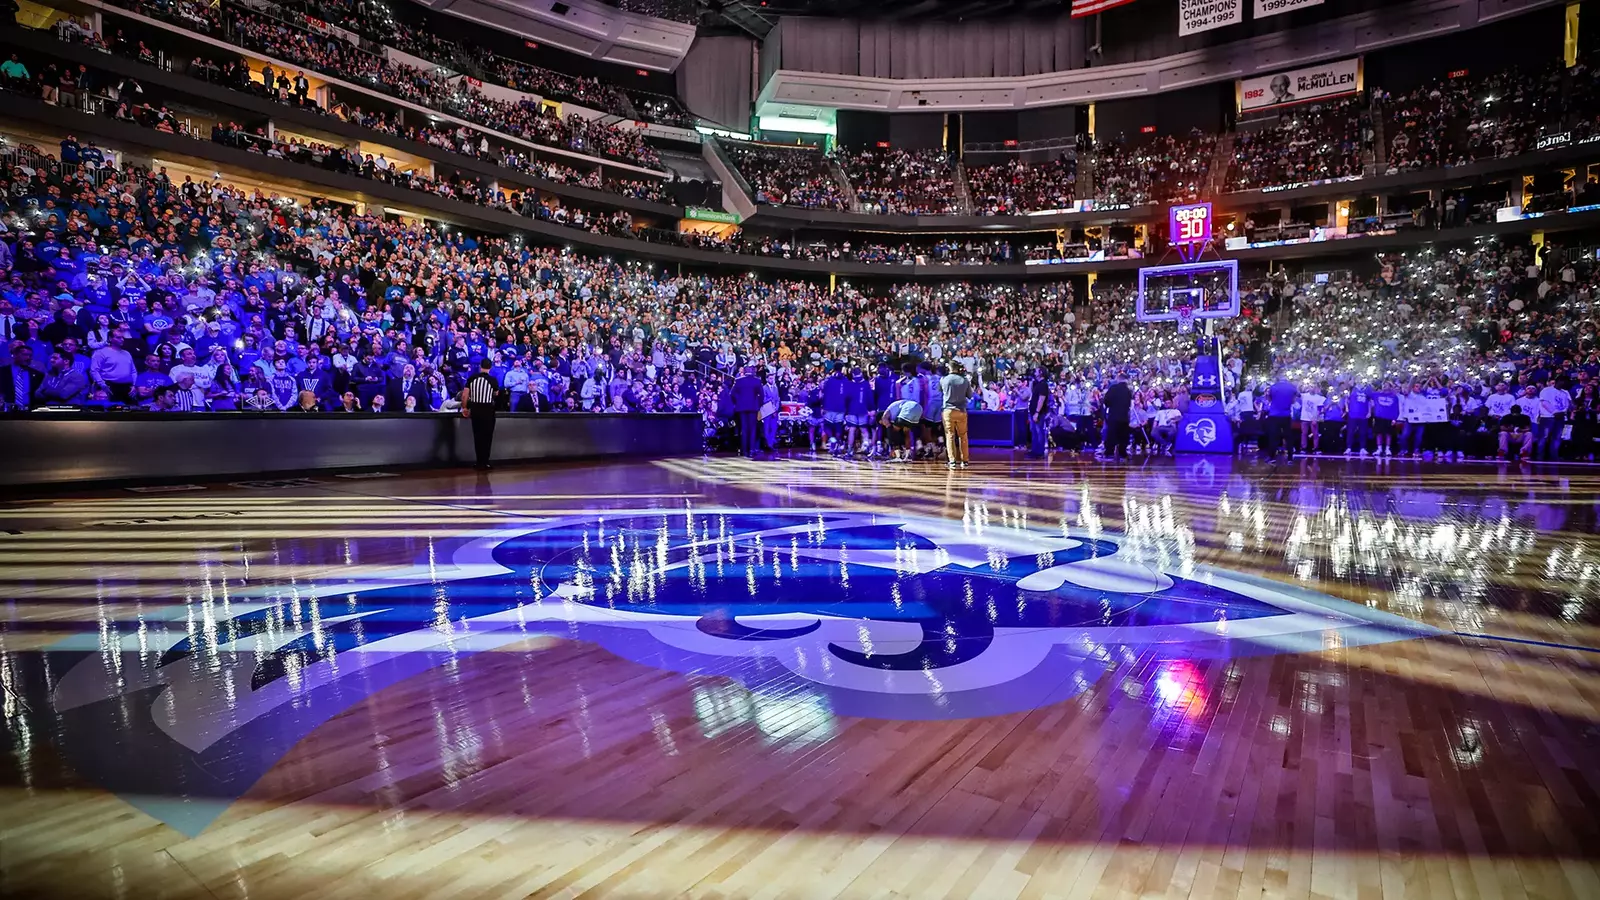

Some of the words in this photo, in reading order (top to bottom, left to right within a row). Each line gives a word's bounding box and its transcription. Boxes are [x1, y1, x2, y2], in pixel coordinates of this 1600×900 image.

[1183, 0, 1237, 20] CHAMPIONS
[1186, 11, 1235, 29] 1994-1995
[1310, 72, 1327, 80] JOHN
[1453, 70, 1465, 78] 102
[1297, 73, 1355, 92] McMULLEN
[1244, 89, 1265, 99] 1982
[1176, 207, 1207, 221] 20:00
[1180, 219, 1203, 238] 30
[302, 378, 319, 392] V
